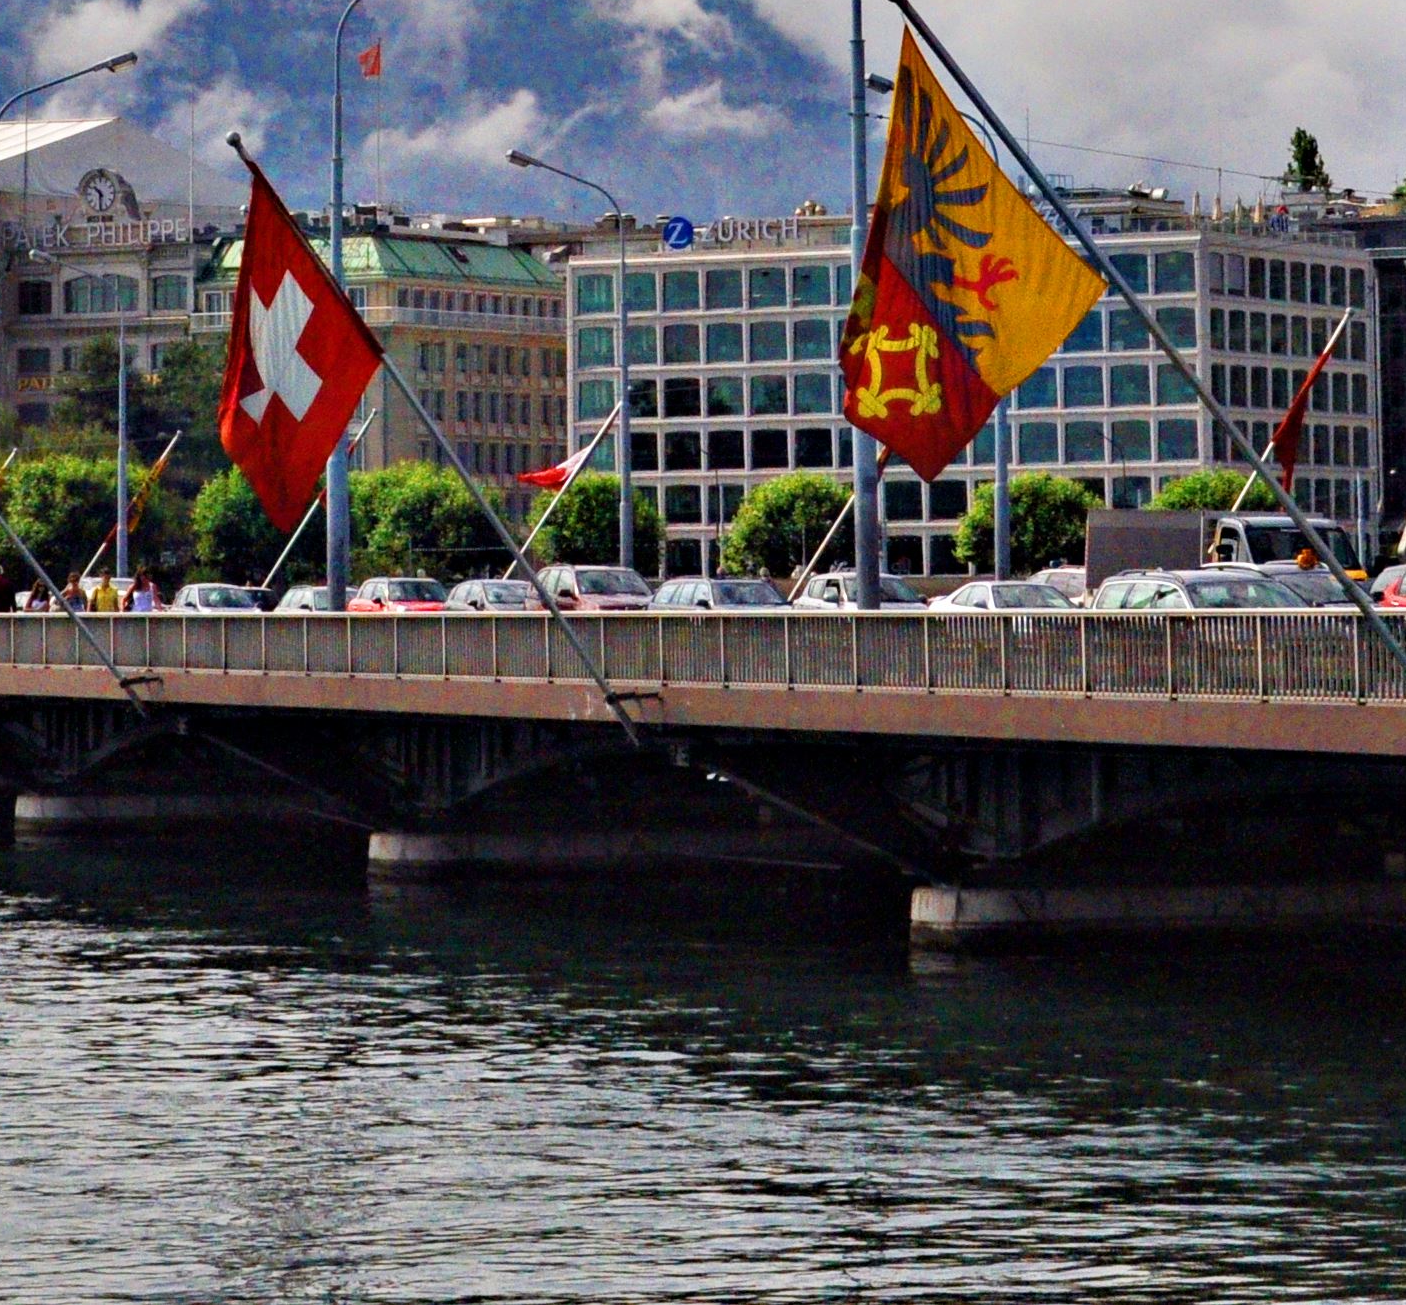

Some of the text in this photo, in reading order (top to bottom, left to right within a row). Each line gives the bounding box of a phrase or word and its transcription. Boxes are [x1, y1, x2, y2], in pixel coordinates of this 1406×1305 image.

[2, 218, 187, 249] PATEK PHILIPPE
[701, 217, 799, 242] ZURICH
